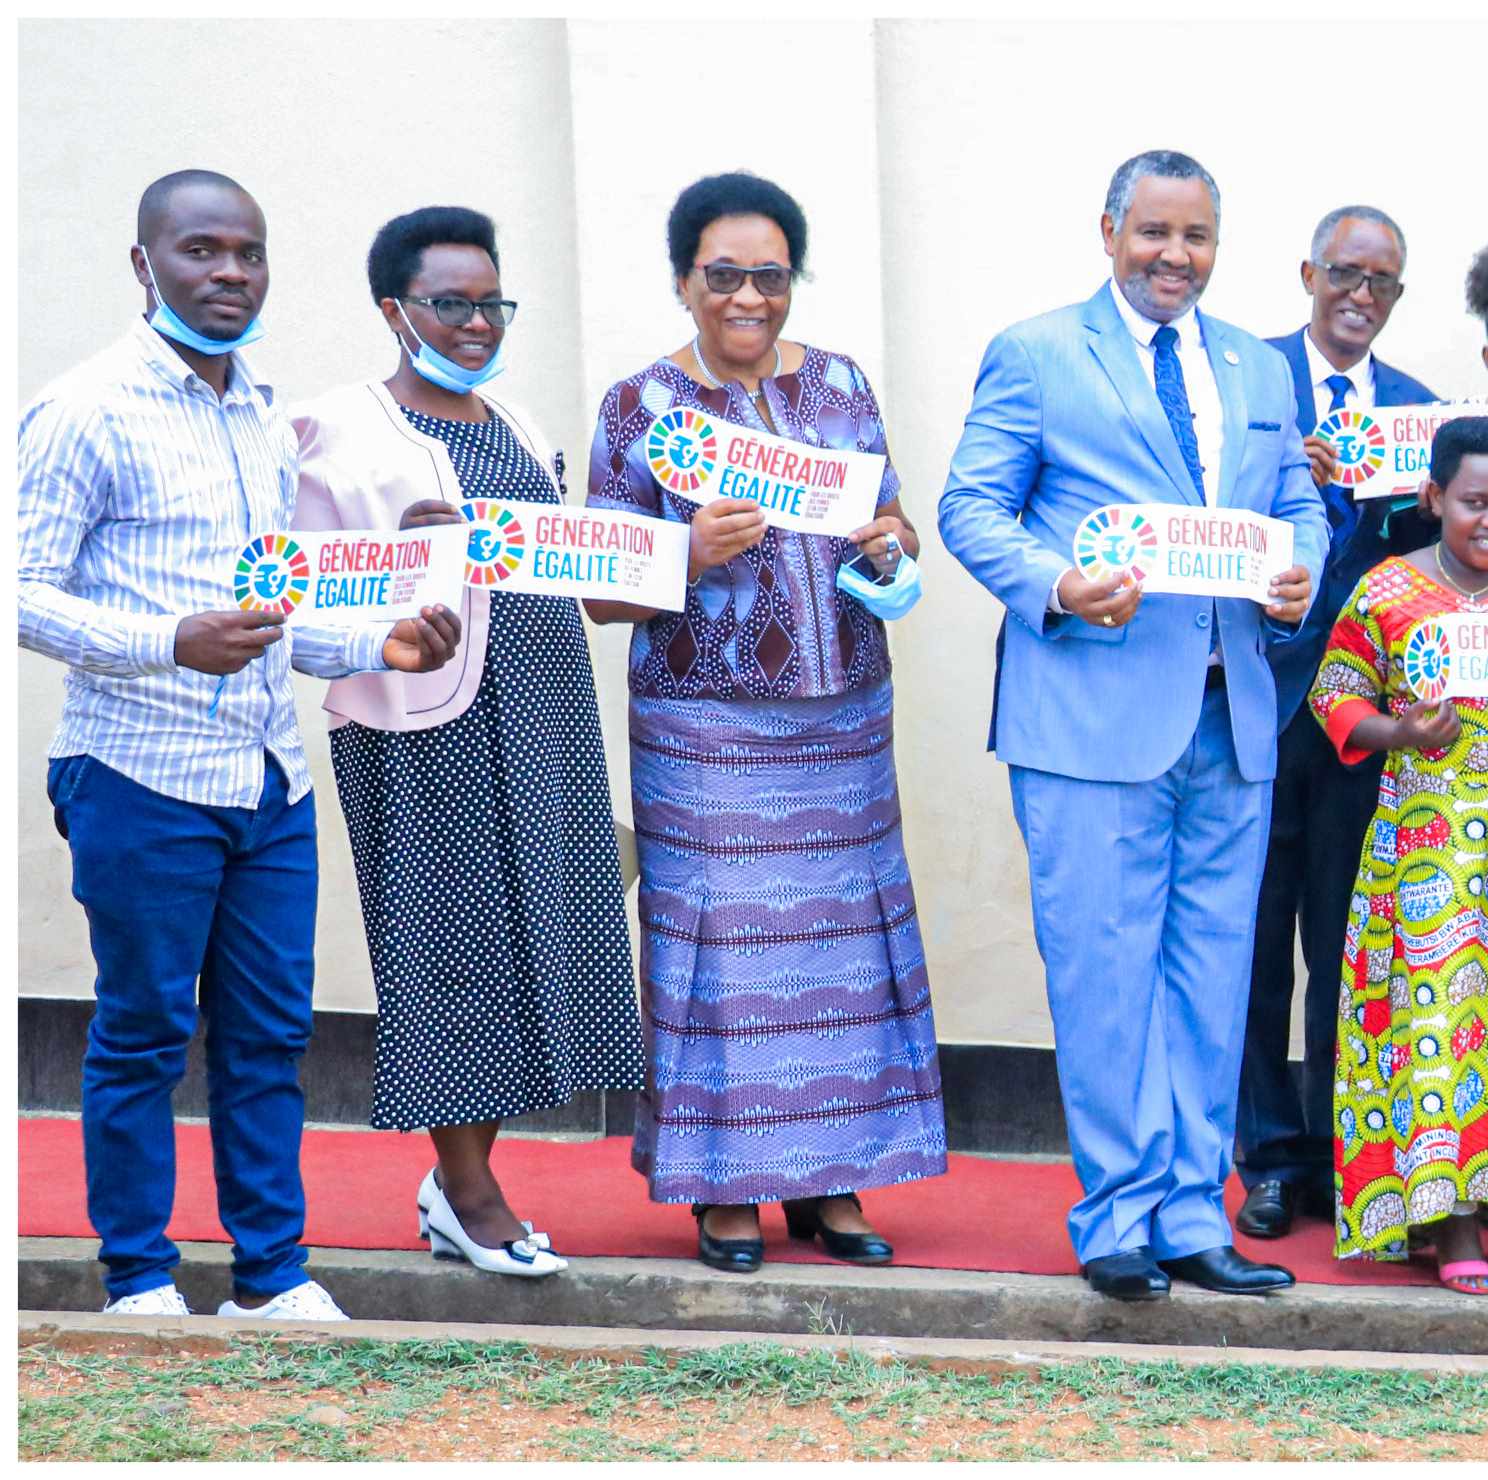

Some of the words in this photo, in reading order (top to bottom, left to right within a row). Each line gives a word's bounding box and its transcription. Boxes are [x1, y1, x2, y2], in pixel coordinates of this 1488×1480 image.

[727, 437, 848, 489] GÉNÉRATION
[718, 466, 806, 516] ÉGALITÉ
[536, 513, 654, 557] GÉNÉRATION
[1167, 515, 1268, 555] GÉNÉRATION
[319, 538, 432, 573] GÉNÉRATION
[533, 546, 620, 584] ÉGALITÉ
[1168, 547, 1246, 581] ÉGALITÉ
[315, 573, 392, 609] ÉGALITÉ
